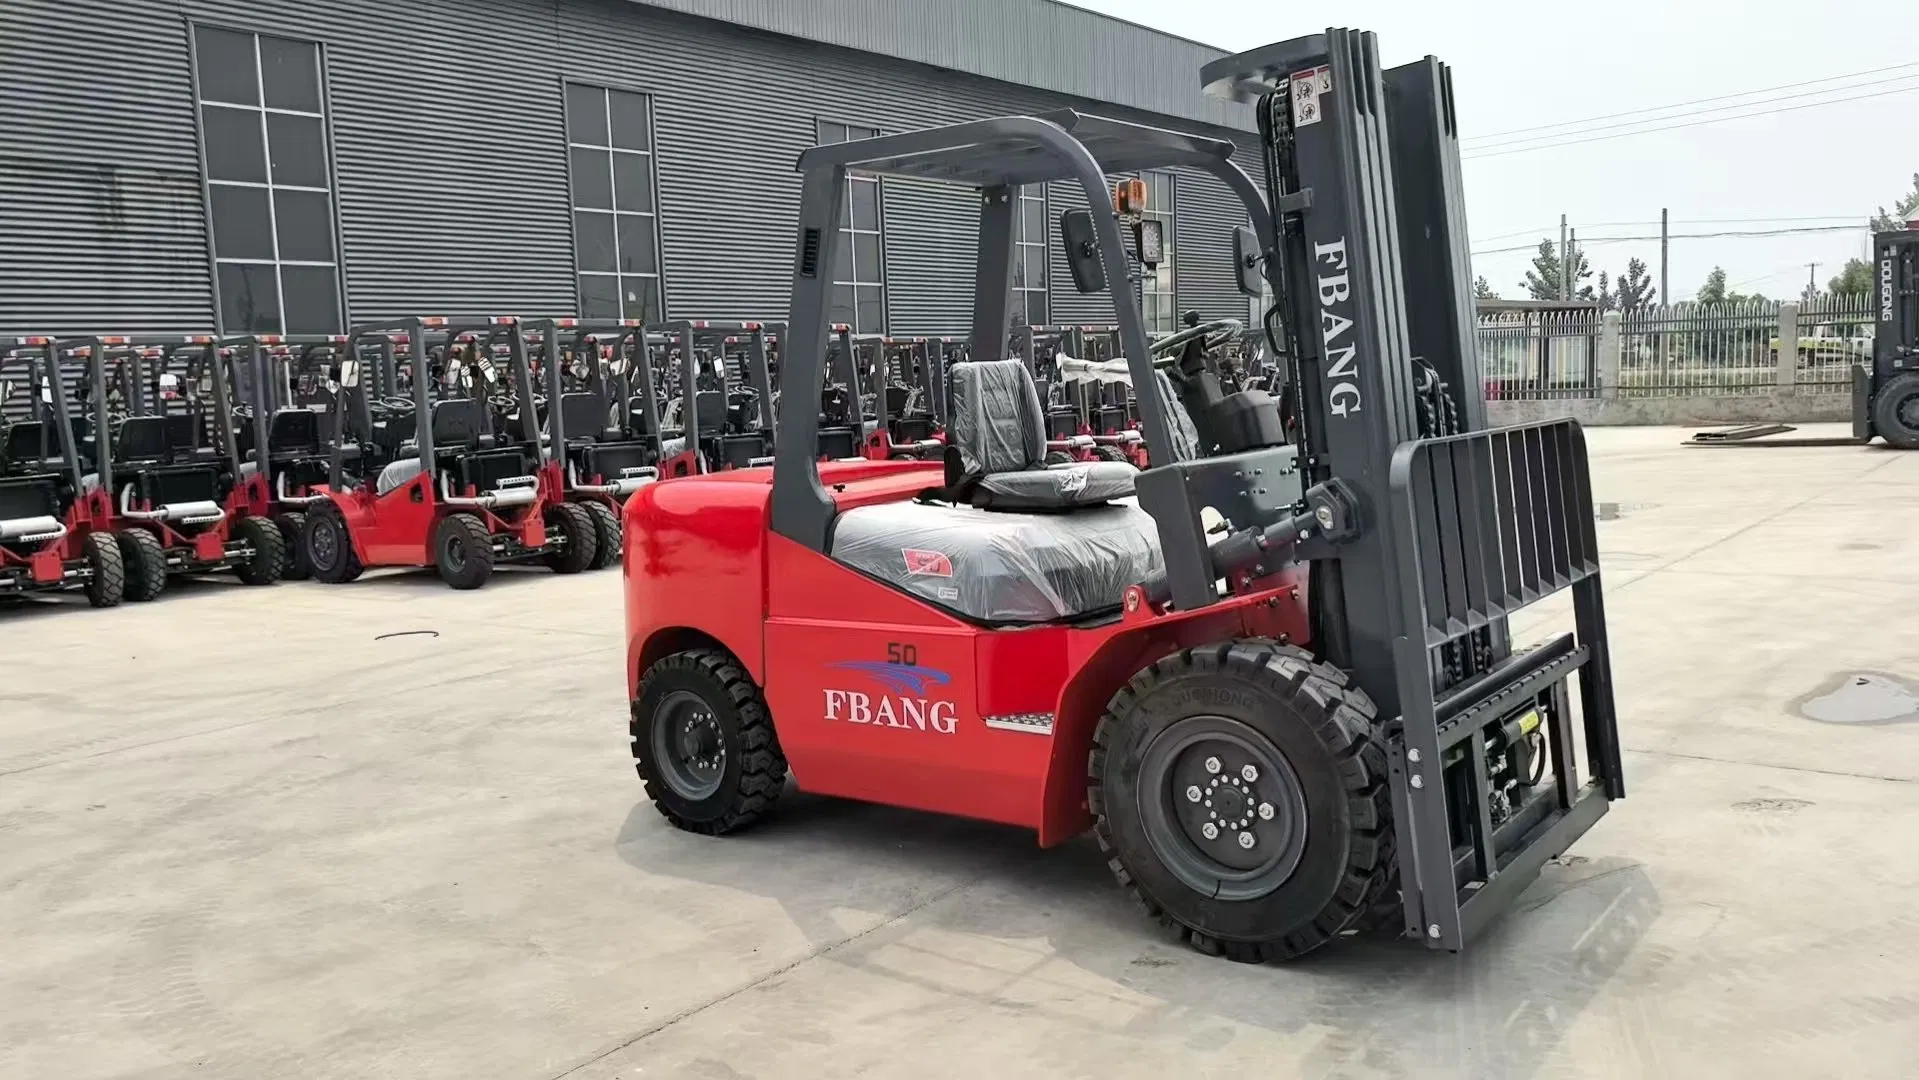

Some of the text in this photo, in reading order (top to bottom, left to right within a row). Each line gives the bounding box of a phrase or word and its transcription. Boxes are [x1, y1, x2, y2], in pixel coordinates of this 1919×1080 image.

[1314, 236, 1361, 419] FBANG
[888, 642, 917, 666] 50
[823, 689, 959, 734] FBANG
